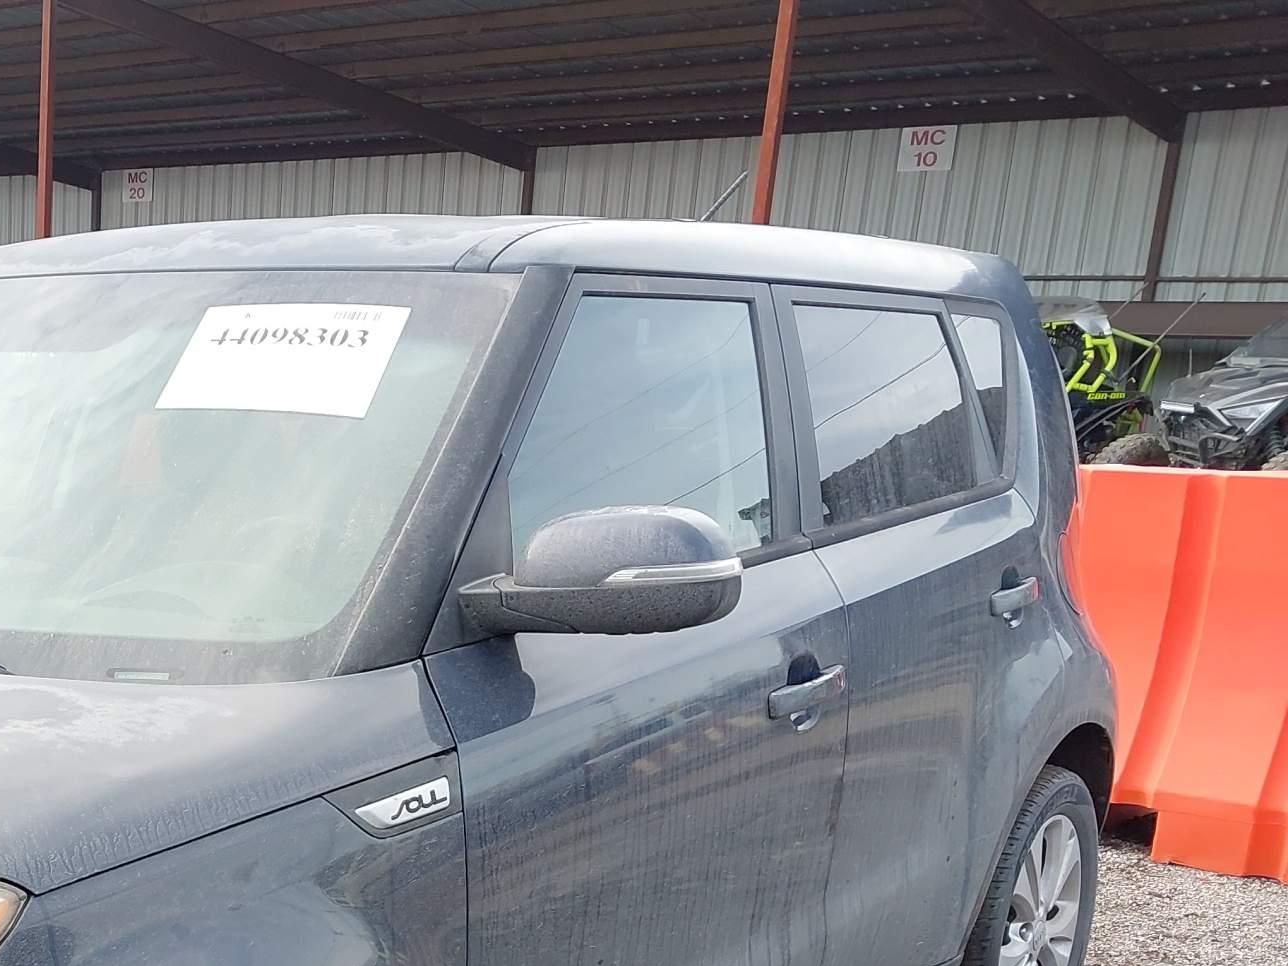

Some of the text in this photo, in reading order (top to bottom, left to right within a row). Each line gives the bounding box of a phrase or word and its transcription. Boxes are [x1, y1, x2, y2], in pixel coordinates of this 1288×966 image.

[910, 129, 946, 146] MC
[913, 151, 938, 167] 10
[127, 171, 148, 184] MC
[129, 187, 145, 199] 20
[210, 327, 369, 348] 44098303
